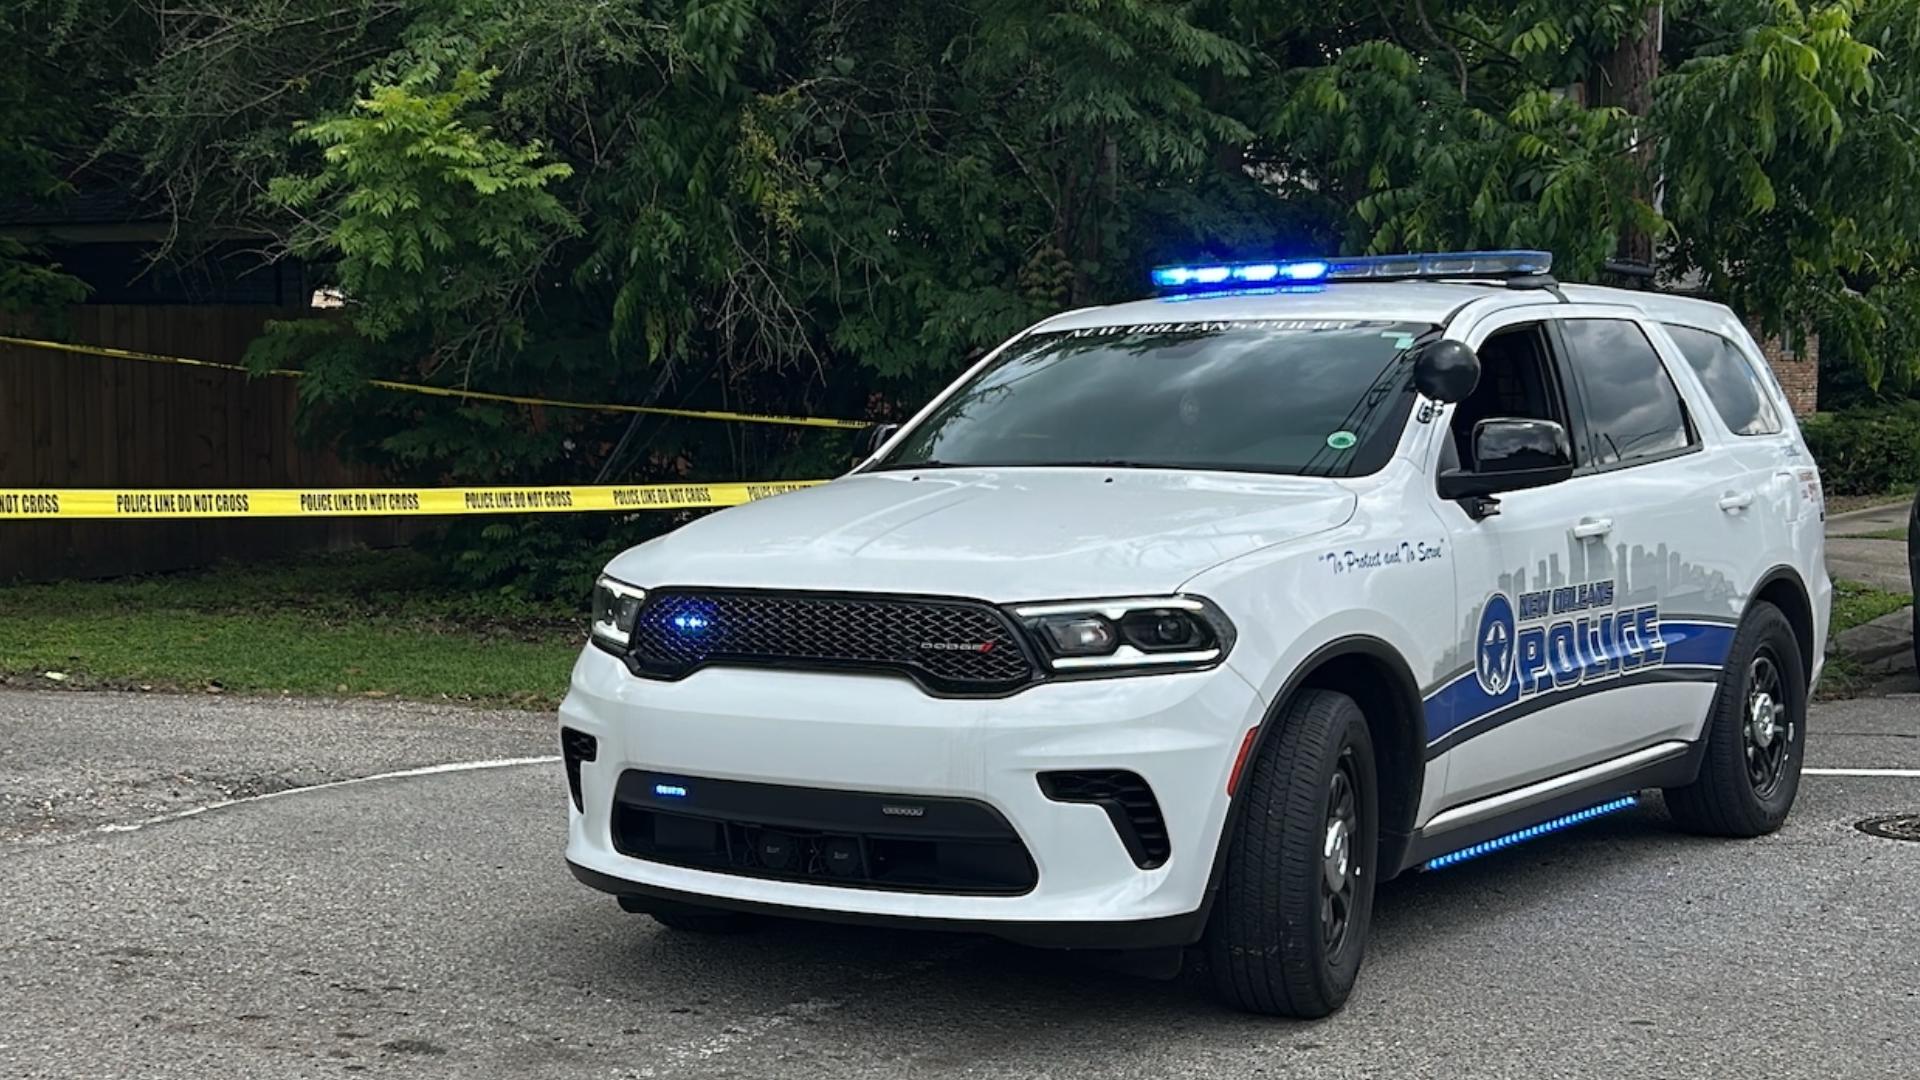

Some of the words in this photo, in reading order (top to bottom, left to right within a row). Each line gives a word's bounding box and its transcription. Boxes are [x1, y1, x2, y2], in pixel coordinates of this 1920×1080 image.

[22, 494, 59, 513] CROSS
[116, 494, 152, 512] POLICE
[154, 494, 176, 512] LINE
[178, 493, 192, 512] DO
[194, 493, 213, 512] NOT
[215, 493, 249, 512] CROSS
[300, 493, 332, 511] POLICE
[334, 493, 354, 511] LINE
[355, 493, 367, 511] DO
[369, 492, 387, 511] NOT
[389, 492, 419, 510] CROSS
[465, 492, 494, 509] POLICE
[495, 492, 513, 508] LINE
[514, 491, 526, 508] DO
[527, 490, 543, 507] NOT
[544, 490, 573, 507] CROSS
[612, 489, 640, 505] POLICE
[640, 488, 657, 504] LINE
[657, 488, 669, 503] DO
[669, 487, 684, 503] NOT
[685, 487, 712, 503] CROSS
[1344, 550, 1381, 573] Protect
[1519, 590, 1551, 621] NEW
[1552, 579, 1614, 615] ORLEANS
[921, 641, 981, 651] DODGE
[1516, 603, 1666, 697] POLICE
